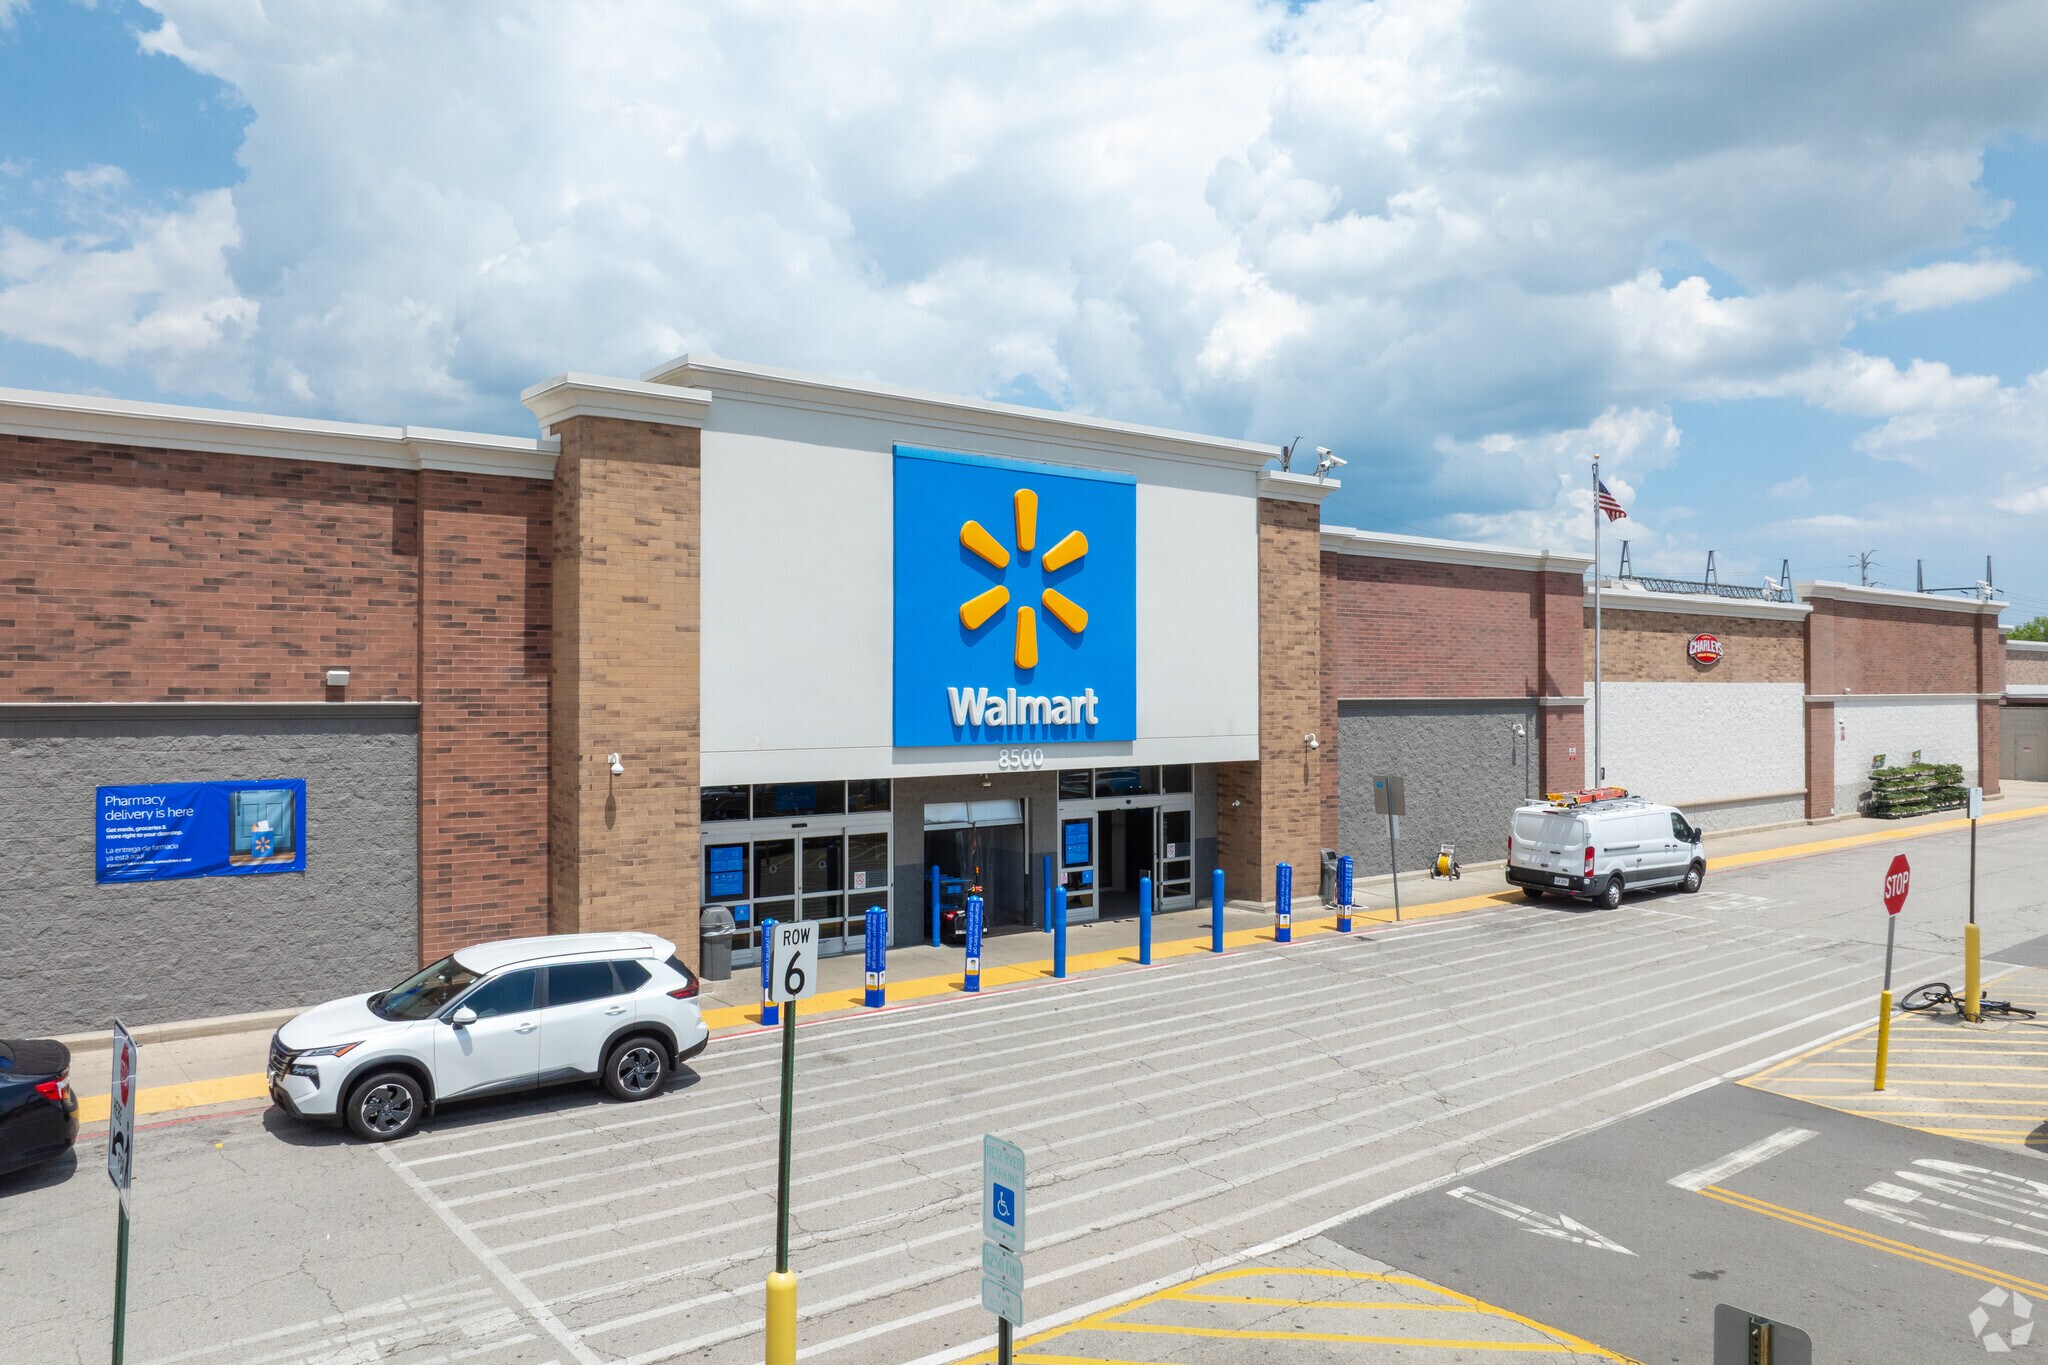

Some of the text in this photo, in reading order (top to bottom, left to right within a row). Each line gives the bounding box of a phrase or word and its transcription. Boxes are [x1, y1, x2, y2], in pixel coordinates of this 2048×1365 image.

[1689, 640, 1724, 656] CHARLEYS
[947, 687, 1099, 726] Walmart
[998, 748, 1044, 768] 8500
[105, 796, 166, 806] Pharmacy
[105, 807, 194, 820] delivery is here
[1885, 871, 1909, 898] STOP
[784, 928, 810, 946] ROW
[785, 950, 805, 996] 6
[986, 1144, 1023, 1171] RESERVED
[990, 1162, 1020, 1188] PARKING
[985, 1251, 1004, 1272] $250
